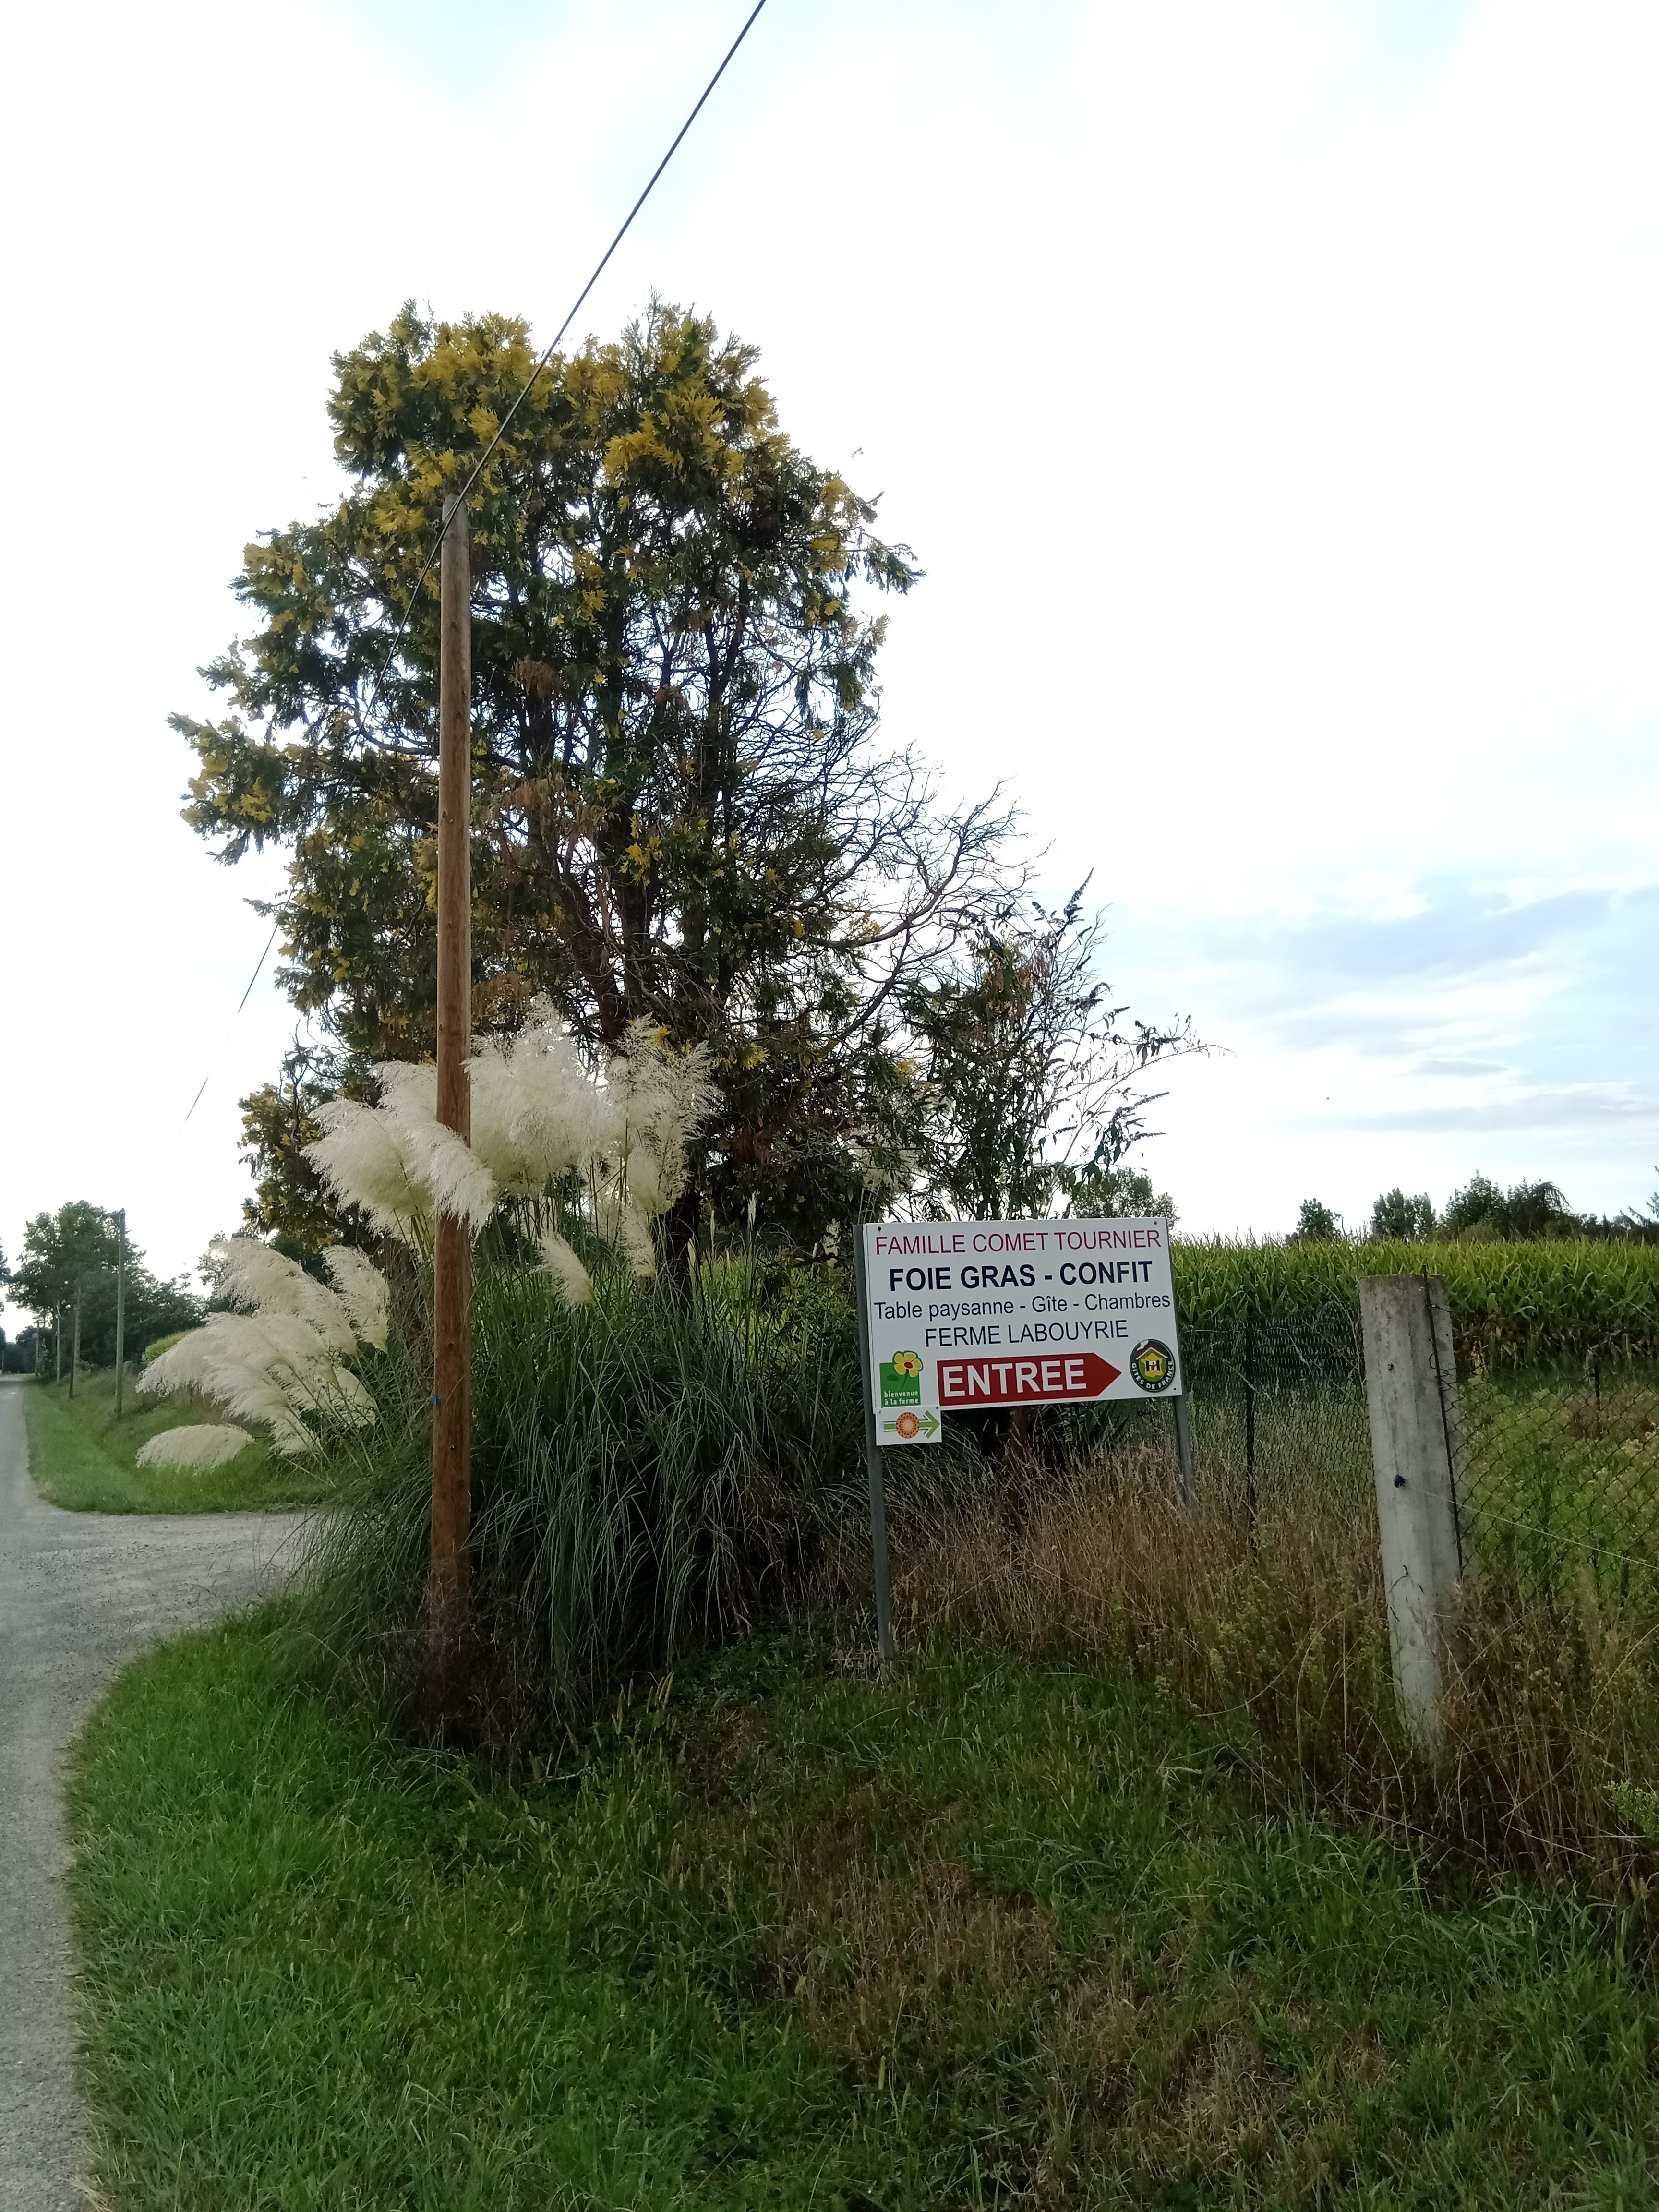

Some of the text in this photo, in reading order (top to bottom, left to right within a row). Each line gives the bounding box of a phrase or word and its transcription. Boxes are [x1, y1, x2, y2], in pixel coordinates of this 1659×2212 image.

[876, 1230, 1161, 1255] FAMILLE COMET TOURNIER
[890, 1267, 952, 1291] FOIE
[961, 1264, 1035, 1288] GRAS
[1060, 1261, 1152, 1285] CONFIT
[874, 1301, 922, 1319] Table
[929, 1300, 1014, 1322] paysanne
[1032, 1296, 1067, 1312] Gîte
[1085, 1292, 1170, 1310] Chambres
[925, 1320, 1129, 1347] FERME LABOUYRIE
[942, 1359, 1086, 1398] ENTREE
[1158, 1361, 1173, 1388] FRANCE
